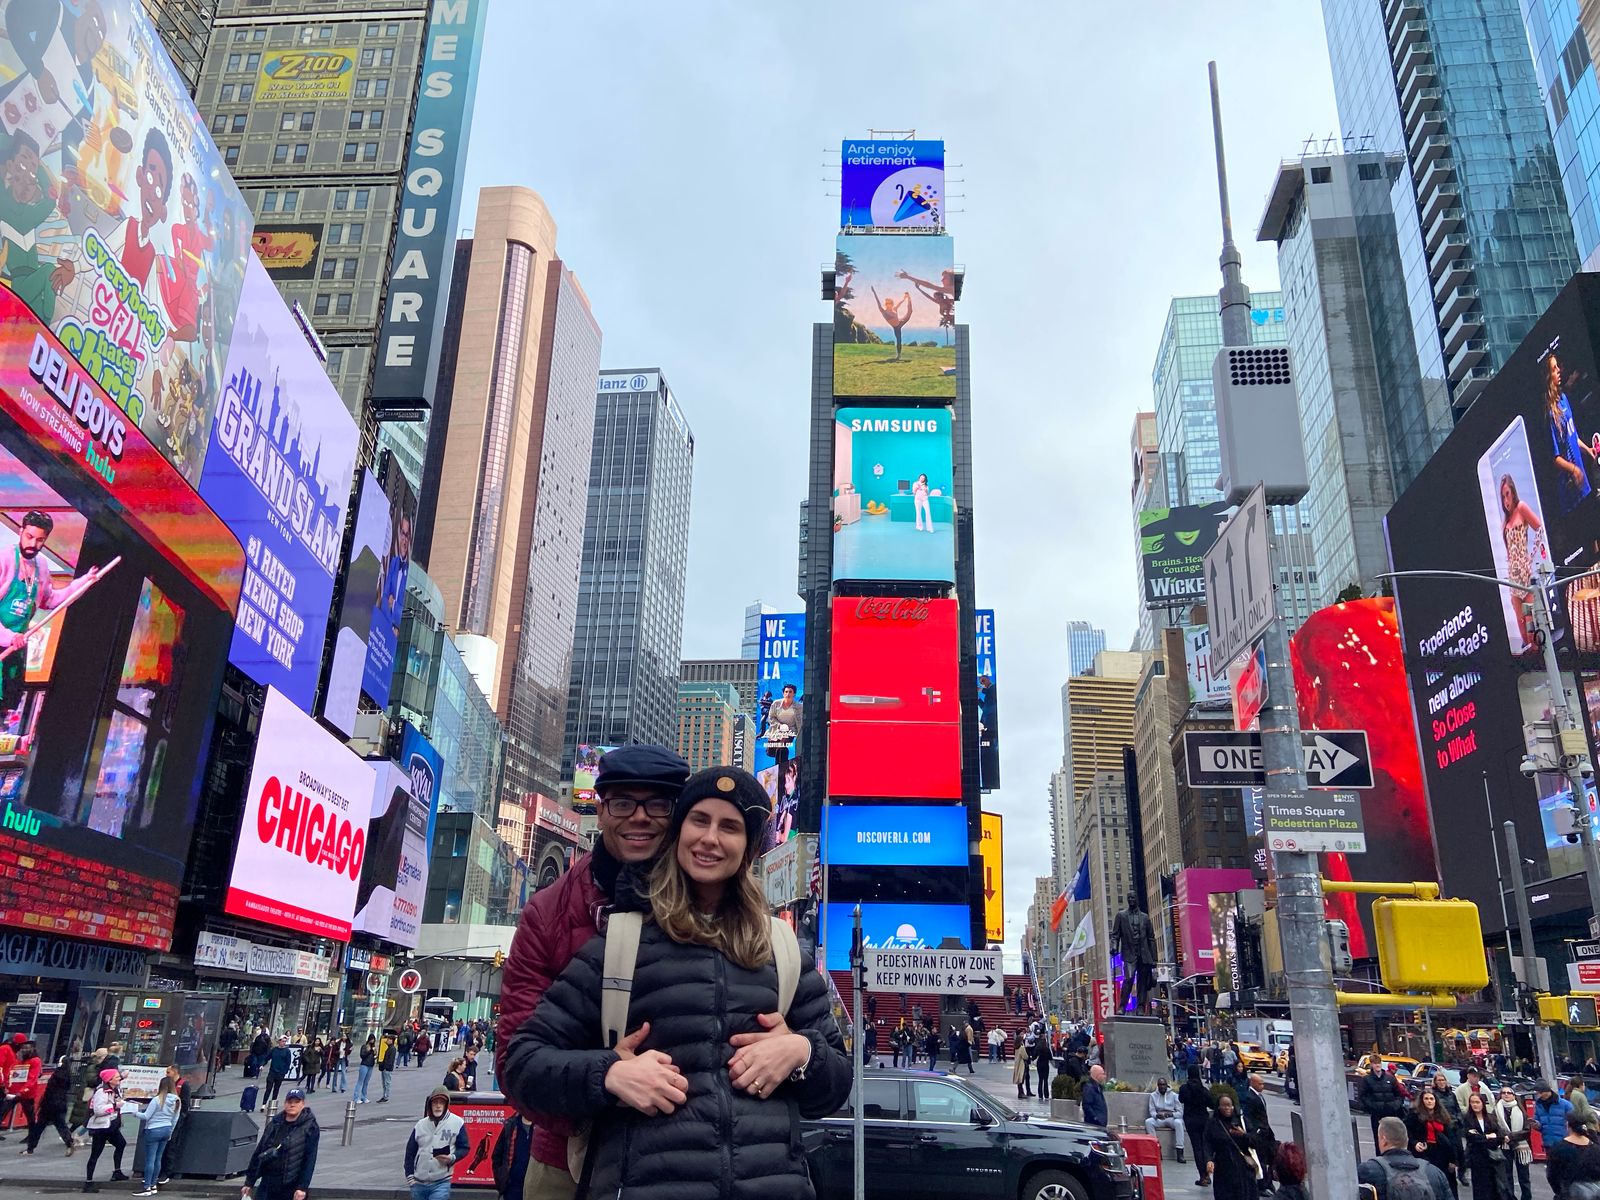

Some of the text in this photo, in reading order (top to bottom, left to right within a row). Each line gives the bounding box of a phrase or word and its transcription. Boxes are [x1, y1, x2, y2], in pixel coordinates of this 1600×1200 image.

[272, 55, 345, 79] Z100
[127, 24, 206, 175] New Stories. New Look.
[269, 81, 340, 91] New York's #1
[311, 90, 347, 98] Station
[144, 81, 187, 165] Same Chris.
[847, 143, 914, 156] And enjoy
[847, 155, 917, 166] retirement
[385, 129, 445, 367] SQUARE
[86, 233, 165, 347] everybody
[96, 330, 137, 376] hates
[29, 333, 126, 457] DELI BOYS
[20, 387, 82, 454] NOW STREAMING
[62, 413, 85, 440] EPISODES
[852, 419, 938, 433] SAMSUNG
[85, 441, 116, 484] hulu
[267, 510, 292, 545] NEW YORK
[247, 535, 296, 602] #1 RATED
[1152, 558, 1184, 568] Brains.
[1163, 564, 1204, 575] Courage.
[235, 598, 296, 672] NEW YORK
[278, 601, 305, 644] SHOP
[765, 619, 786, 637] WE
[1214, 594, 1268, 667] ONLY ONLY ONLY
[1419, 605, 1473, 657] Experience
[764, 640, 799, 659] LOVE
[1443, 624, 1488, 657] Rae's
[763, 661, 781, 680] LA
[1428, 672, 1481, 714] new album
[1433, 701, 1476, 742] So Close
[1213, 749, 1341, 770] ONE AY
[1437, 729, 1477, 769] to What
[299, 770, 350, 812] BROADWAY'S BEST BET
[4, 803, 41, 836] hulu
[257, 775, 365, 881] CHICAGO
[1268, 805, 1345, 818] Times Square
[1270, 818, 1358, 829] Pedestrian Plaza
[857, 832, 931, 843] DISCOVERLA.COM
[0, 932, 147, 977] AGLE OUTFITTERS
[876, 954, 996, 971] PEDESTRIAN FLOW ZONE
[1582, 946, 1599, 955] ONE
[876, 973, 942, 987] KEEP MOVING
[138, 1020, 152, 1028] OP
